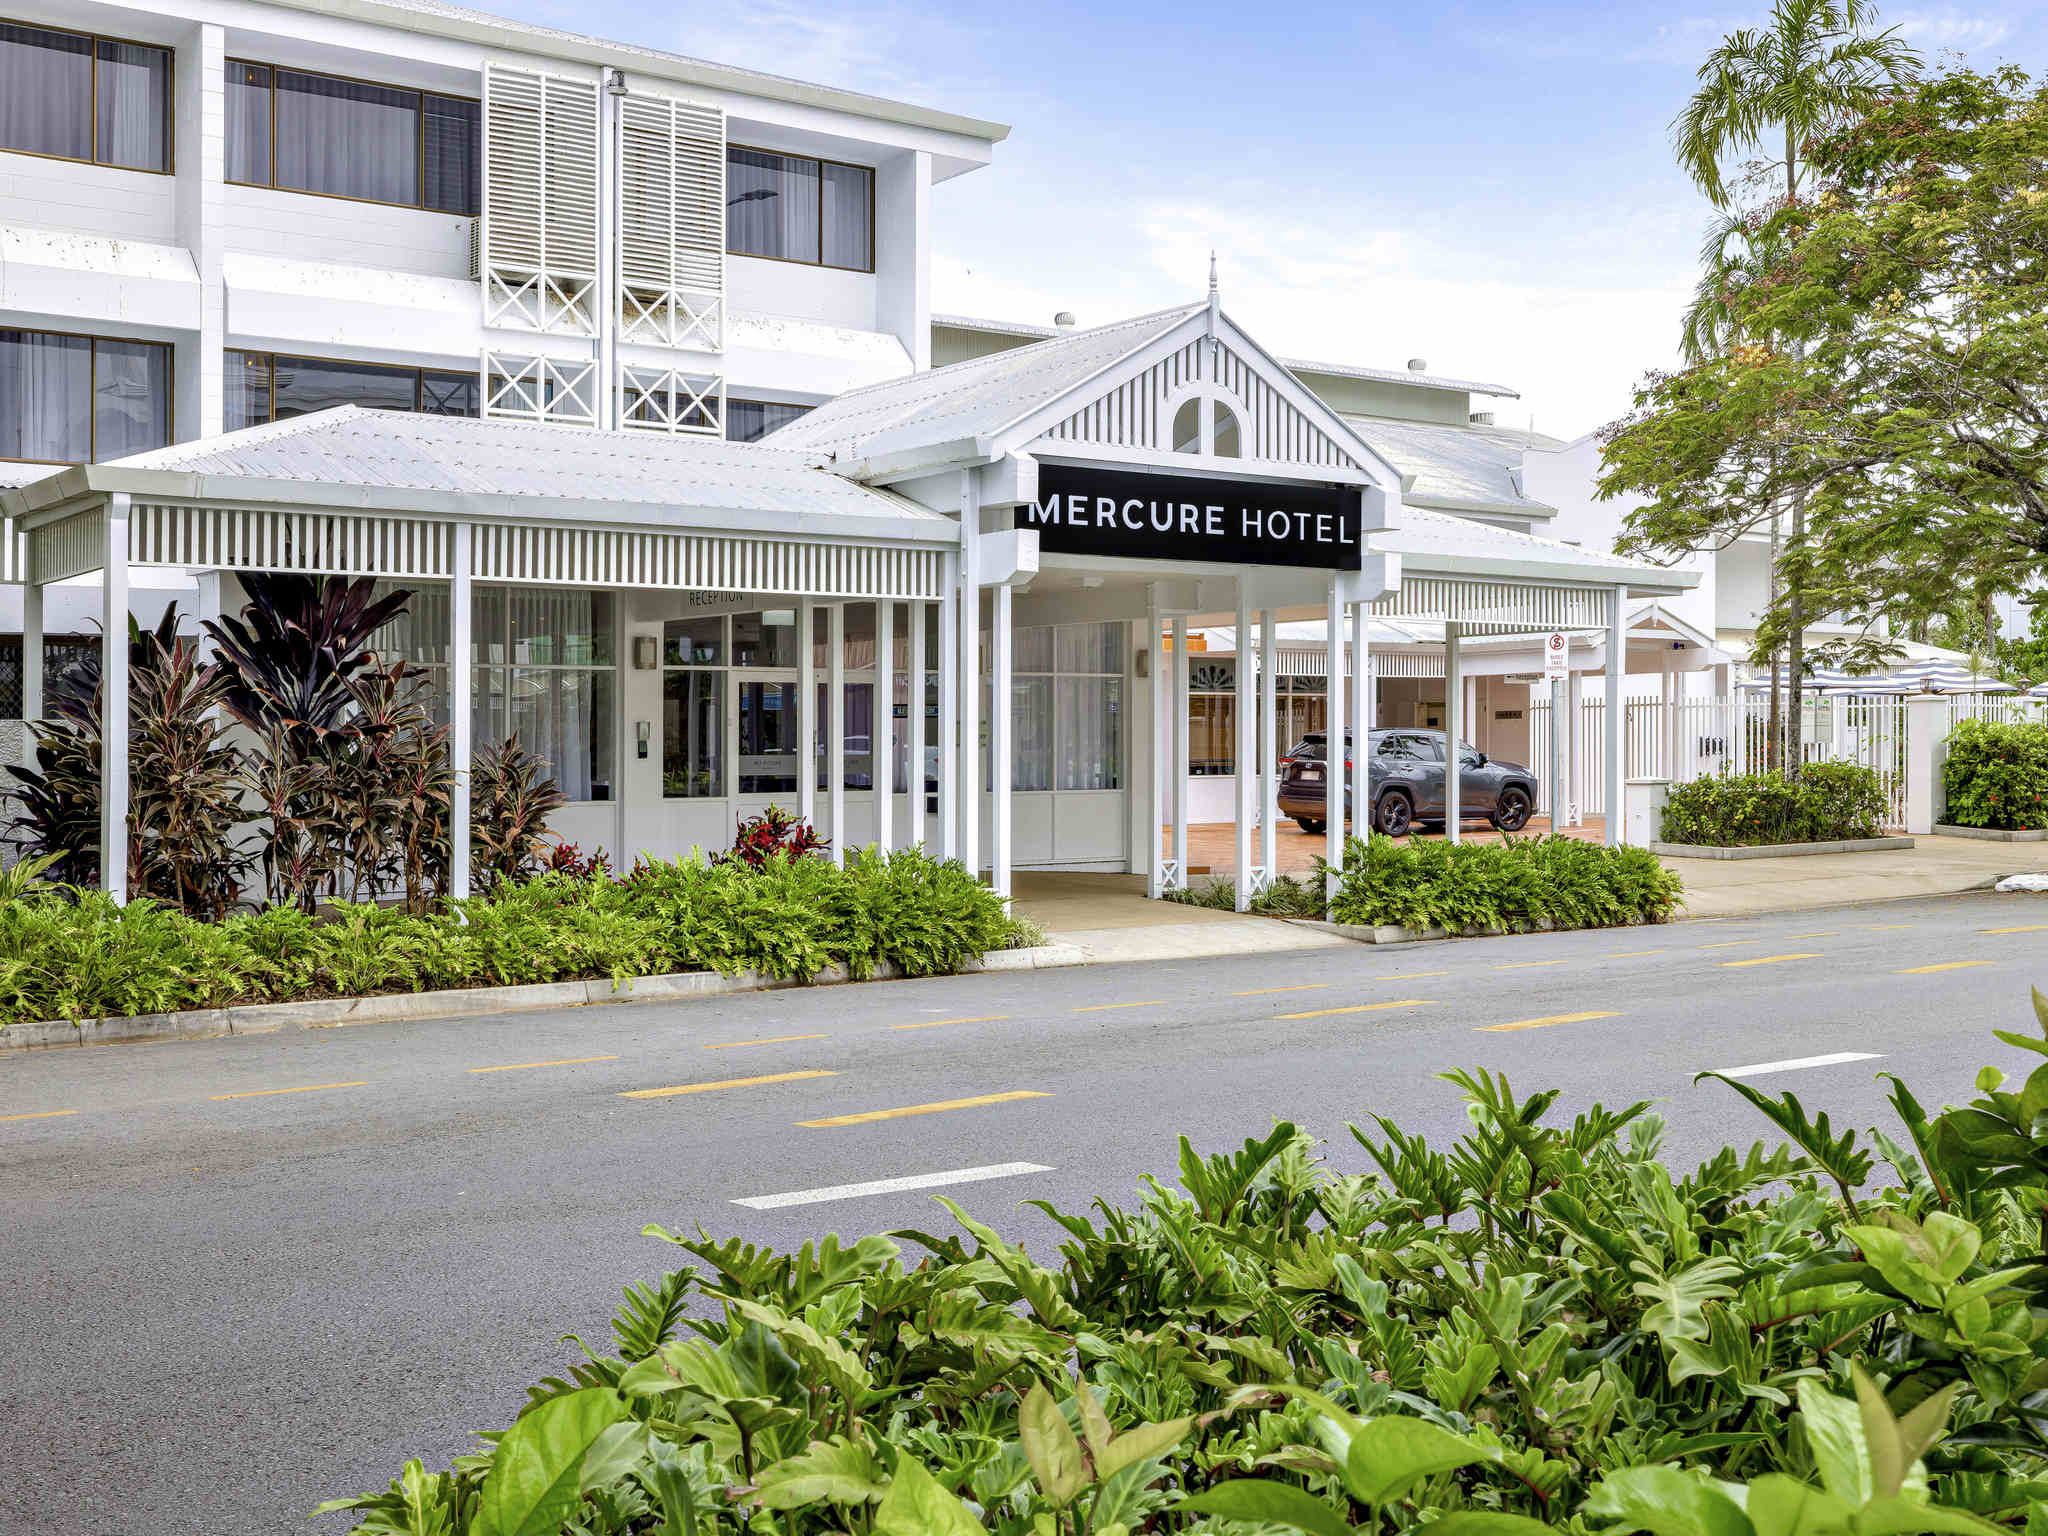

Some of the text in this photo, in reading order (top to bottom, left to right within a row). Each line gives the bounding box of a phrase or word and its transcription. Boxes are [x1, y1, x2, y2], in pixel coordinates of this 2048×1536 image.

[1028, 494, 1354, 544] MERCURE HOTEL
[689, 590, 743, 607] RECEPTION
